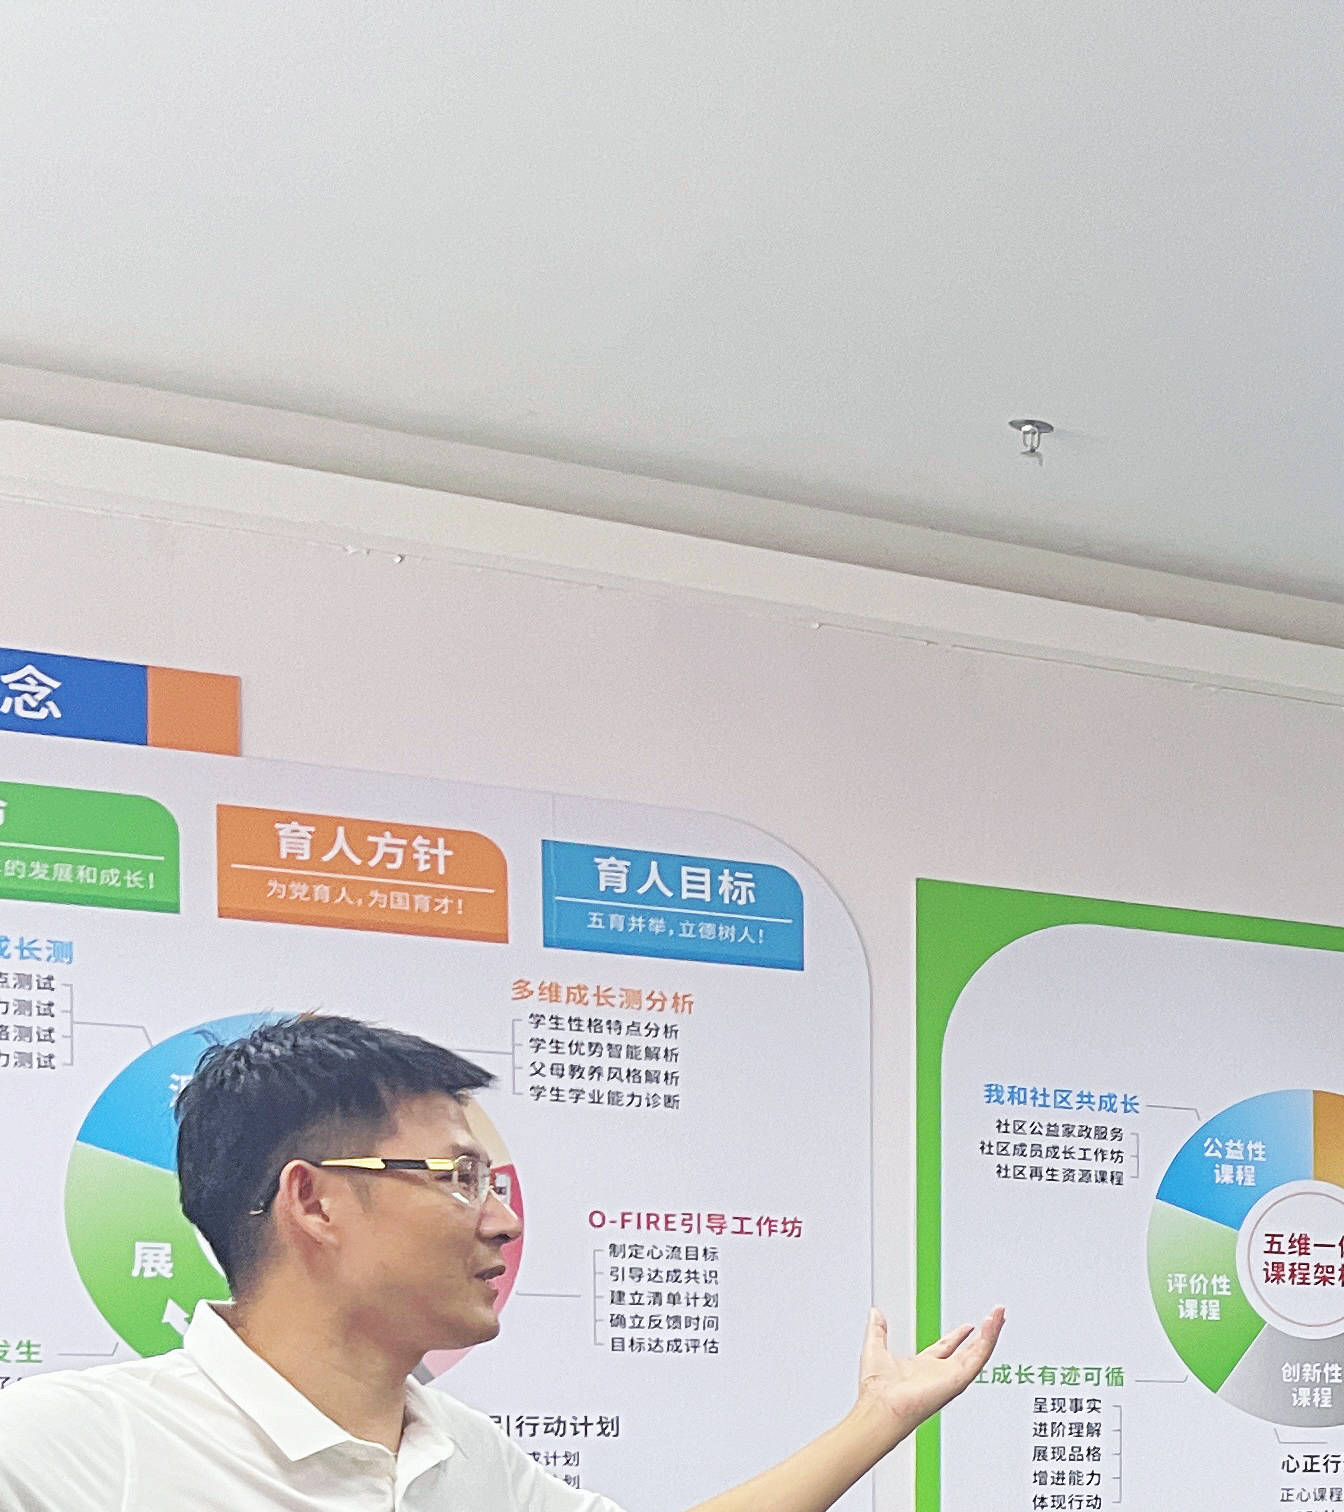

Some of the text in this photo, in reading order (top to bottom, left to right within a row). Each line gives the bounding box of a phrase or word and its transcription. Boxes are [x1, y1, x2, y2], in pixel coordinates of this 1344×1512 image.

[273, 821, 454, 875] 育人方针
[0, 858, 155, 889] 的发展和成长!
[594, 856, 756, 906] 育人目标
[511, 978, 695, 1016] 多维成长测分析
[528, 1012, 680, 1040] 学生性格特点分析
[528, 1037, 680, 1064] 学生优势智能解析
[529, 1060, 680, 1087] 父母教养风格解析
[529, 1085, 680, 1110] 学生学业能力诊断
[983, 1083, 1140, 1114] 我和社区共成长
[995, 1118, 1124, 1143] 社区公益家政服务
[979, 1140, 1125, 1165] 社区成员成长工作坊
[1203, 1137, 1266, 1162] 公益性
[995, 1163, 1124, 1187] 社区再生资源课程
[1213, 1163, 1256, 1187] 课程
[587, 1210, 803, 1238] O-FIRE引导工作坊
[131, 1241, 174, 1278] 展
[608, 1243, 719, 1262] 制定心流目标
[609, 1266, 719, 1286] 引导达成共识
[1167, 1272, 1232, 1297] 评价性
[609, 1289, 719, 1309] 建立清单计划
[1178, 1298, 1221, 1321] 课程
[609, 1312, 719, 1332] 确立反馈时间
[610, 1336, 720, 1355] 目标达成评估
[1281, 1361, 1343, 1384] 创新性
[1033, 1397, 1102, 1415] 呈现事实
[1291, 1387, 1333, 1409] 课程
[1032, 1421, 1102, 1439] 进阶理解
[1032, 1445, 1102, 1463] 展现品格
[1032, 1469, 1102, 1487] 增进能力
[1032, 1494, 1102, 1511] 体现行动
